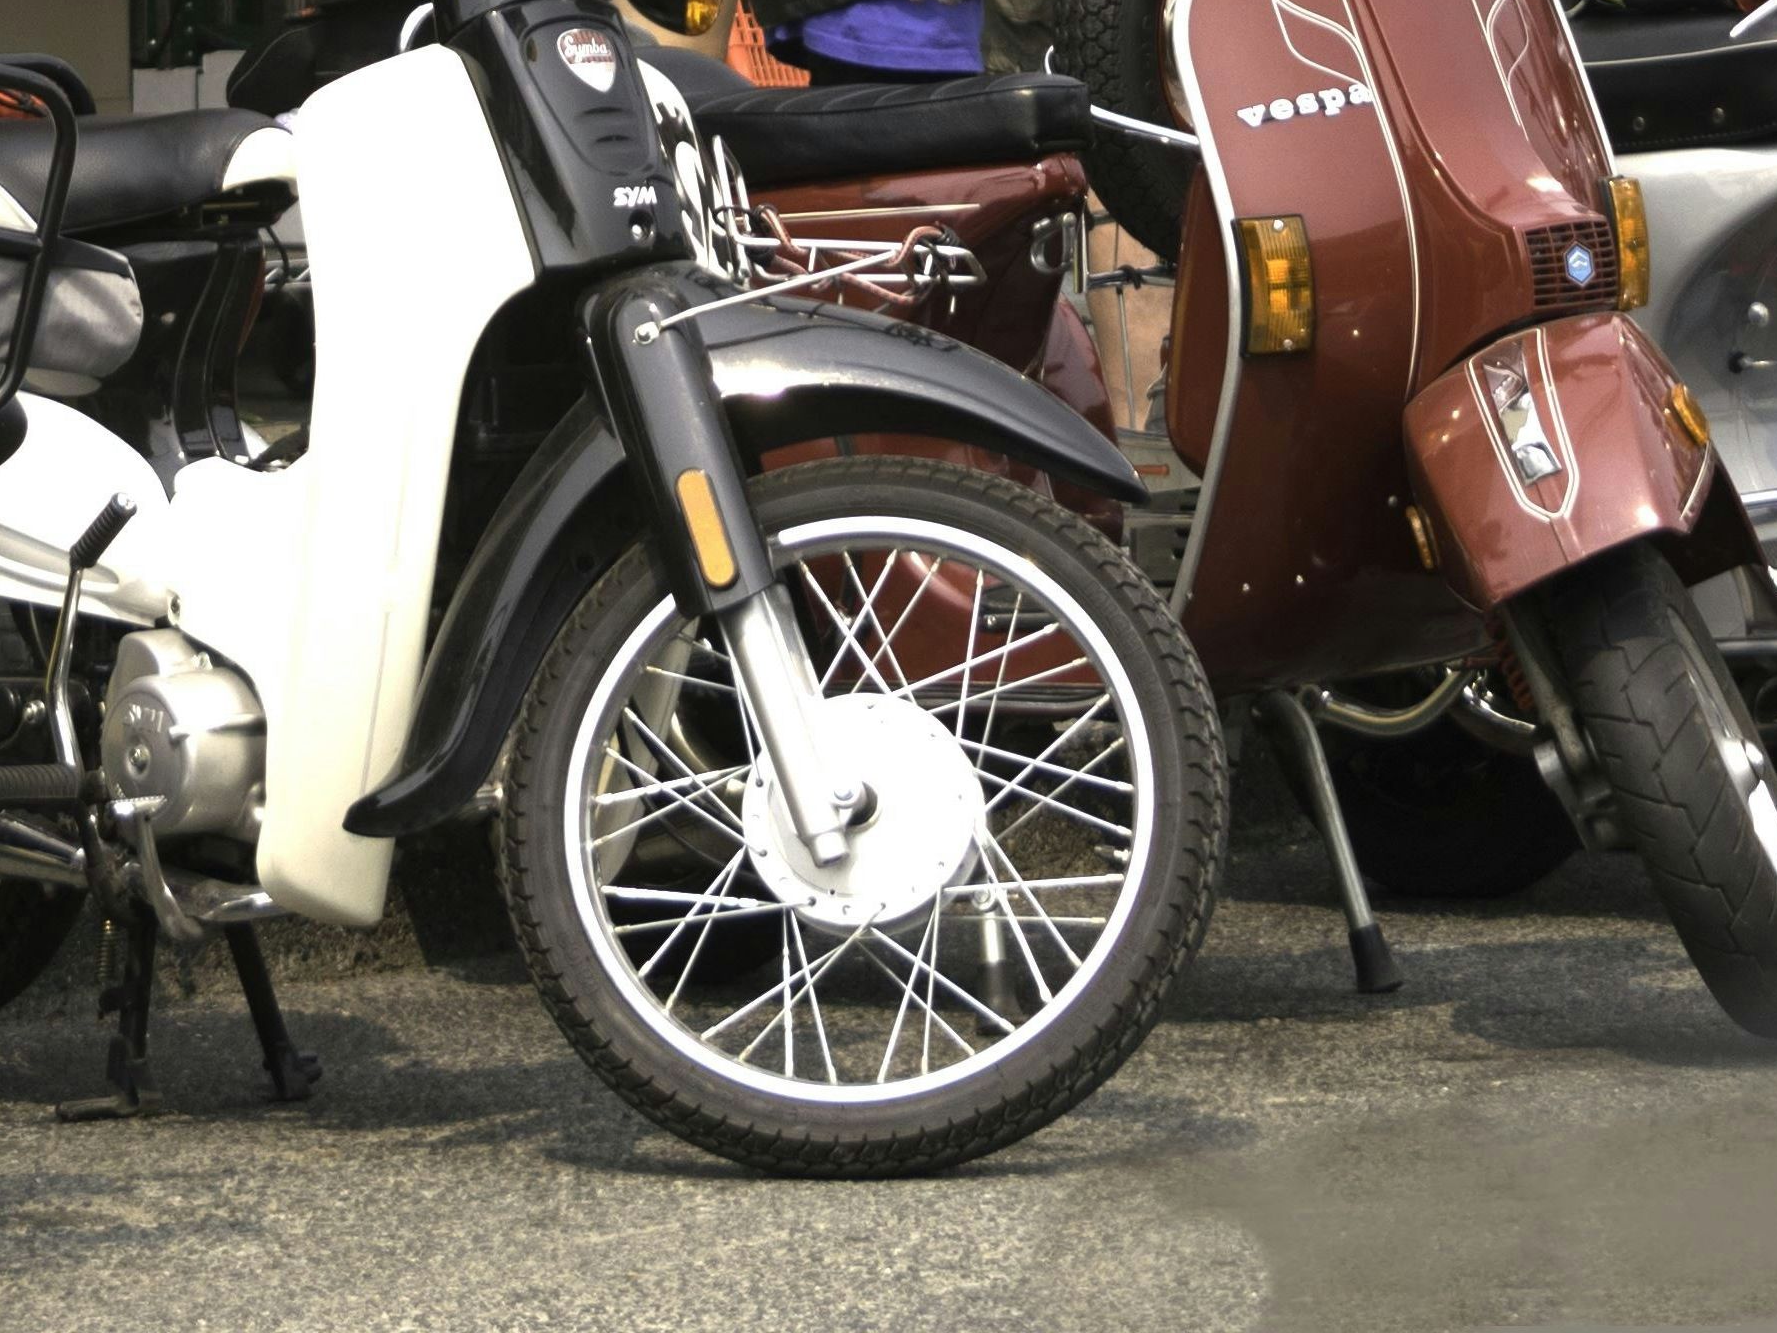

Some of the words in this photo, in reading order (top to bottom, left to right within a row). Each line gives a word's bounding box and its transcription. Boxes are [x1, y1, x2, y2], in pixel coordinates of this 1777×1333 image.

[563, 35, 610, 64] Symba
[1236, 83, 1375, 128] vespa
[613, 185, 658, 207] SYM
